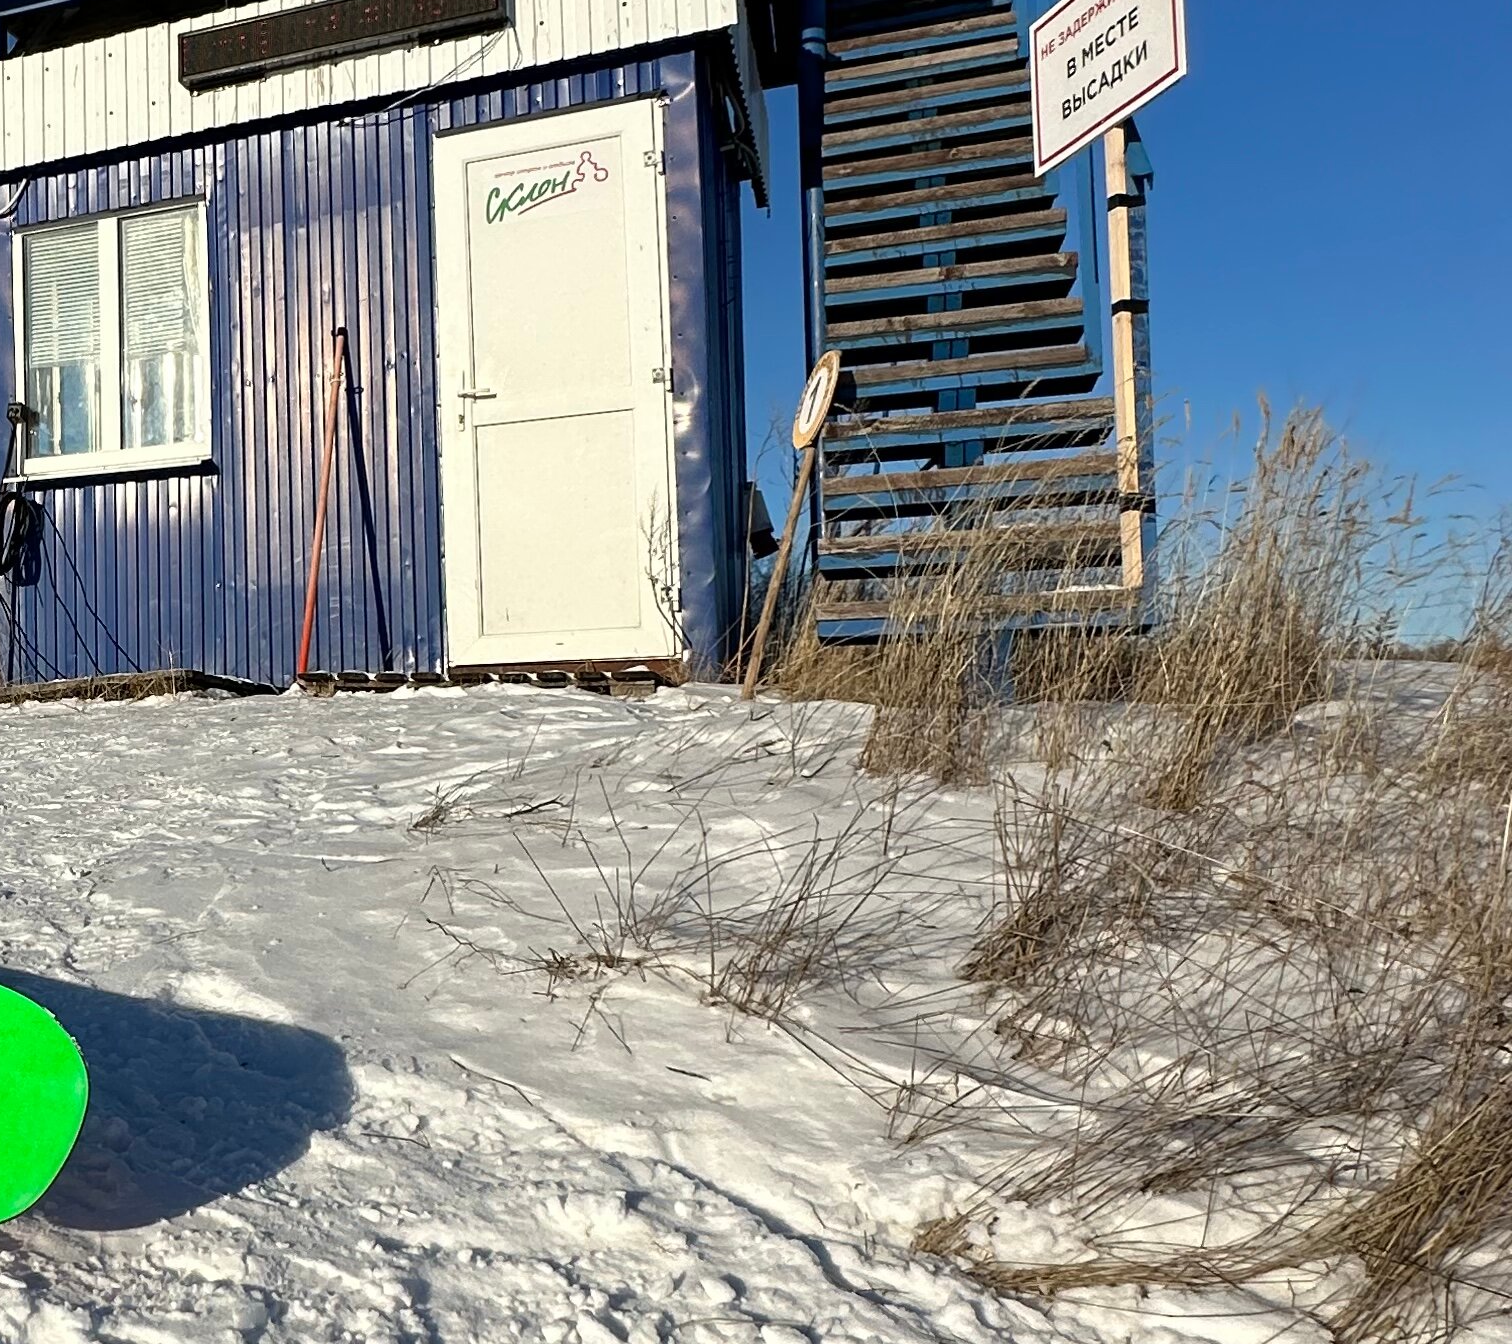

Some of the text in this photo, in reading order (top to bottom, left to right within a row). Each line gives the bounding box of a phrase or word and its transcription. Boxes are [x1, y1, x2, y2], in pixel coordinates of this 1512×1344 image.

[1040, 38, 1056, 61] НЕ
[1066, 6, 1140, 79] В МЕСТЕ
[1061, 40, 1148, 120] ВЫСАДКИ
